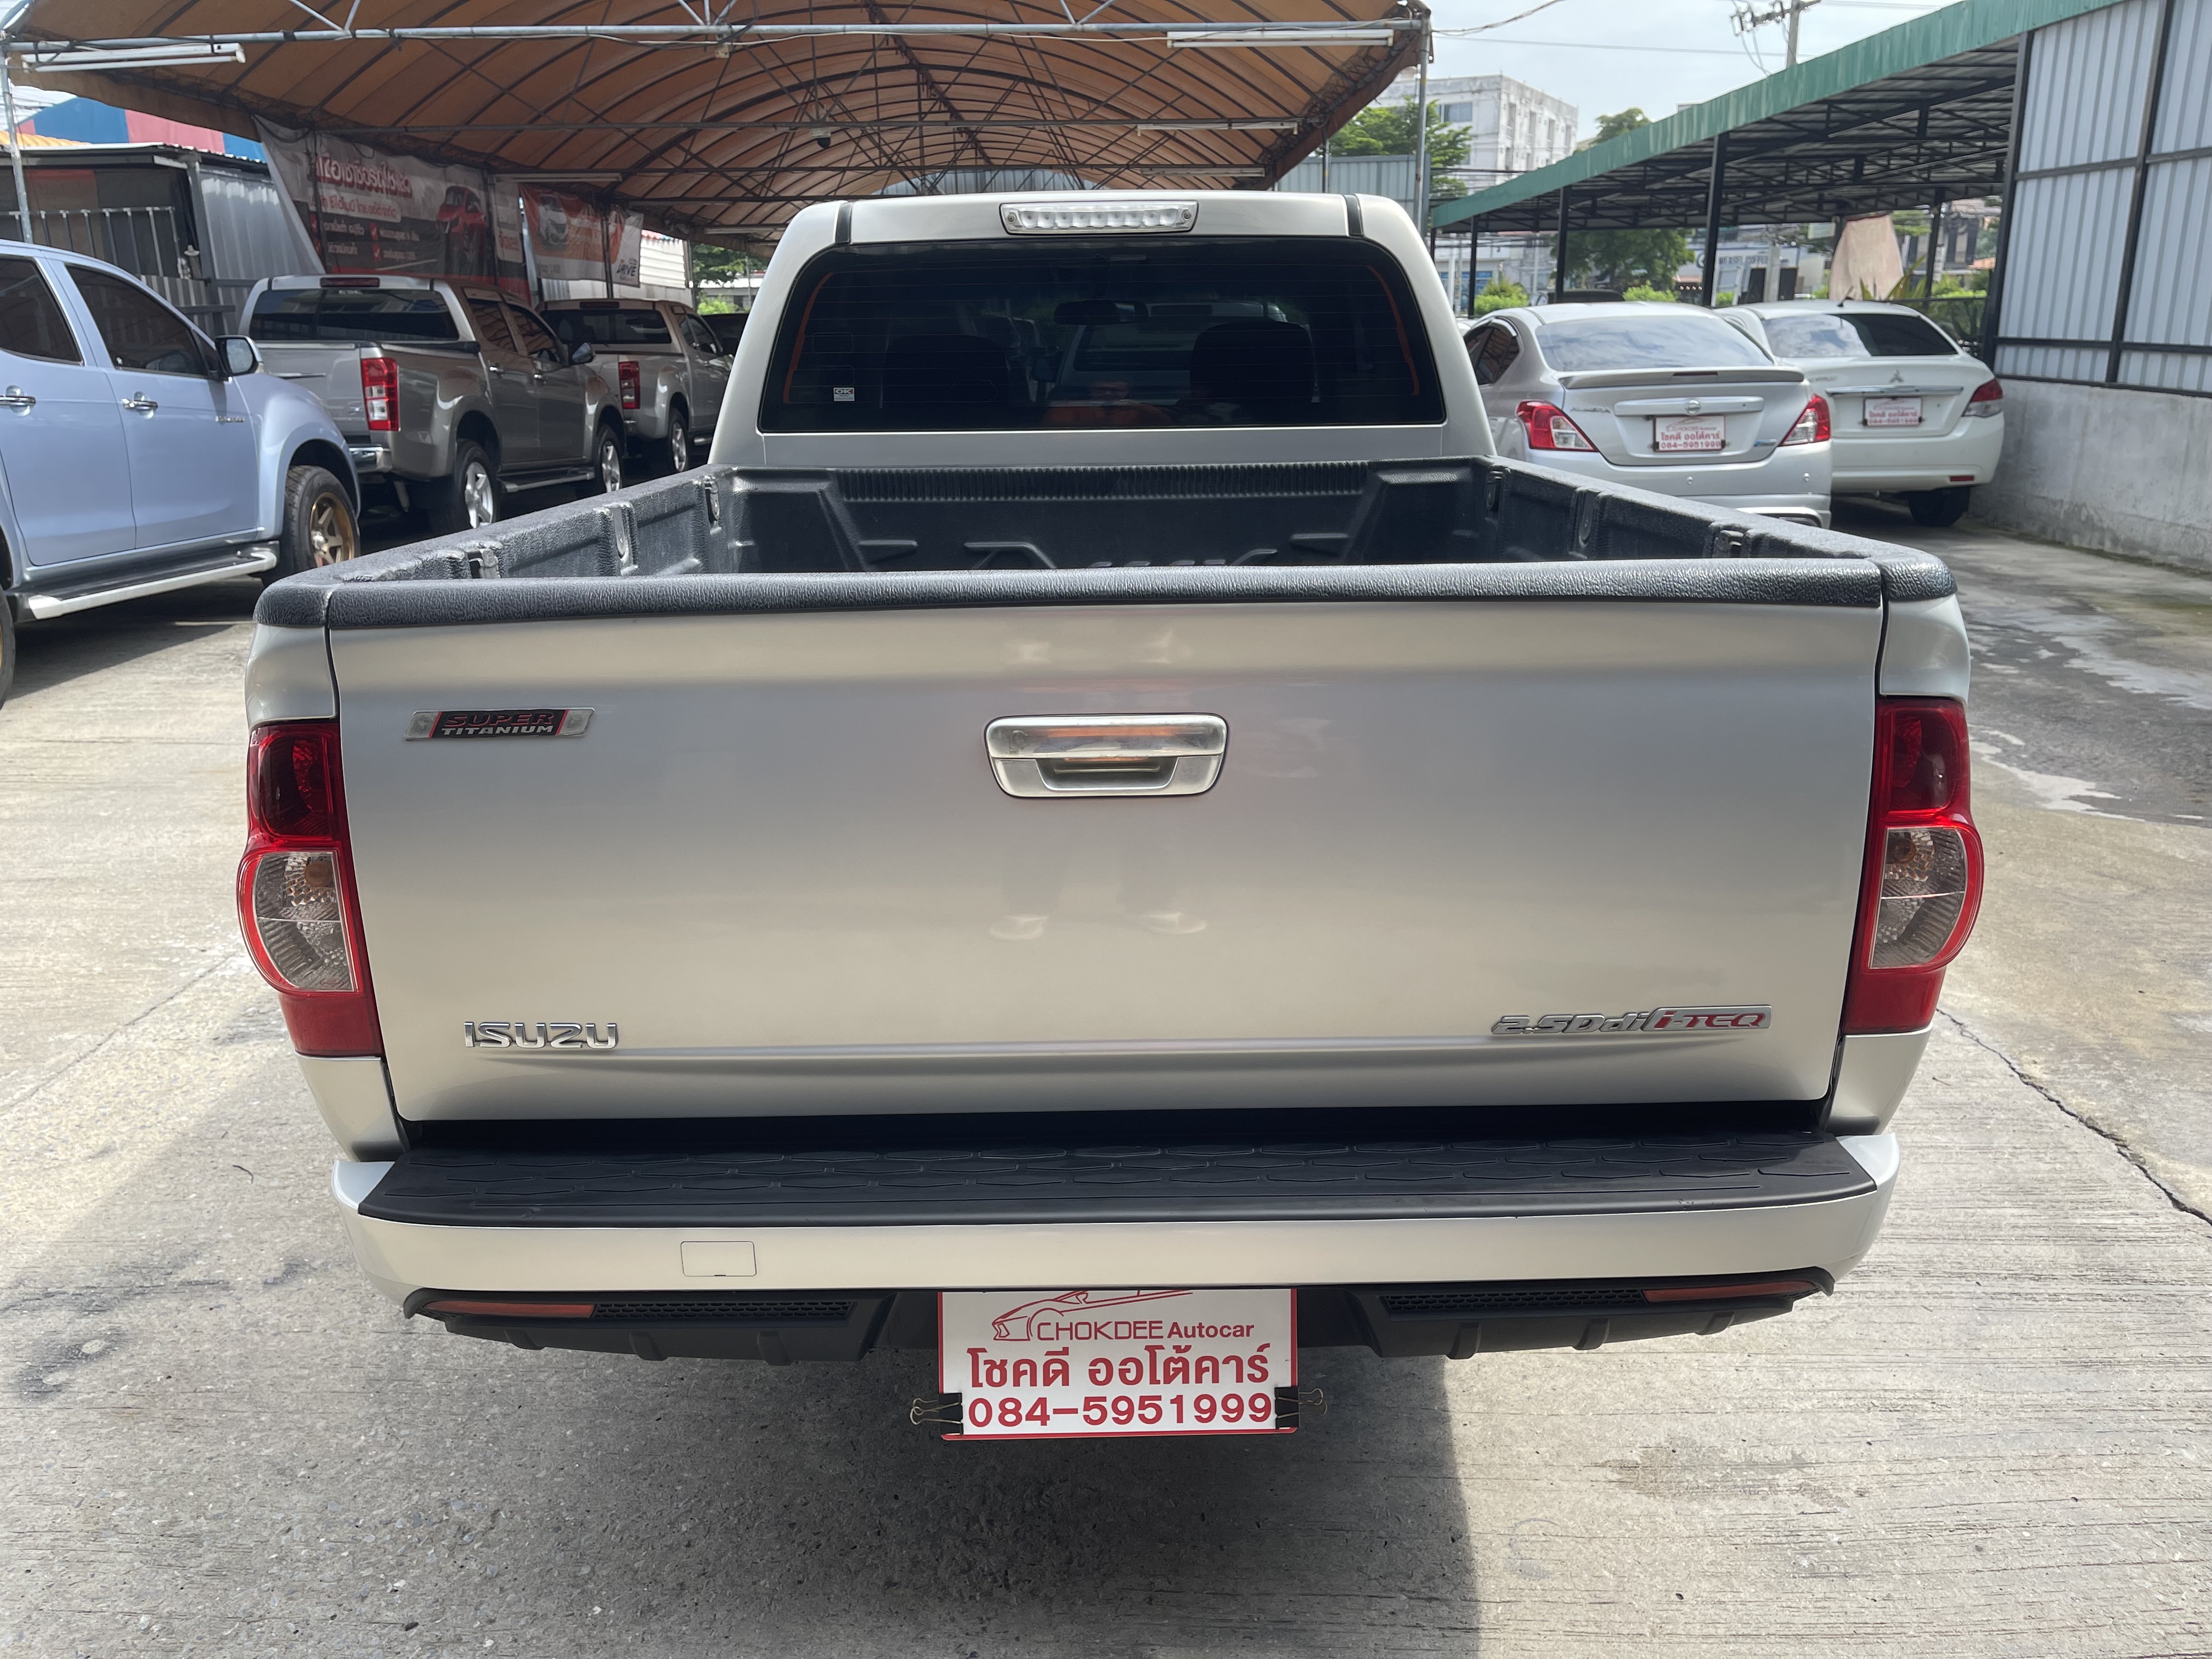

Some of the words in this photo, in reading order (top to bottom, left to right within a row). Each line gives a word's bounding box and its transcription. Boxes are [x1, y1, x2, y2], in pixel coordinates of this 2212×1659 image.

[1661, 431, 1681, 441] โชคดี
[1661, 441, 1722, 449] 084-5951999
[444, 712, 555, 726] SUPER
[441, 725, 554, 736] TITANIUM
[464, 1021, 619, 1049] ISUZU
[1036, 1320, 1164, 1341] CHOKDEE
[1167, 1321, 1255, 1339] Autocar
[966, 1346, 1070, 1389] โชคดี
[1088, 1342, 1272, 1387] ออโต้คาร์
[968, 1392, 1273, 1429] 084-5951999
